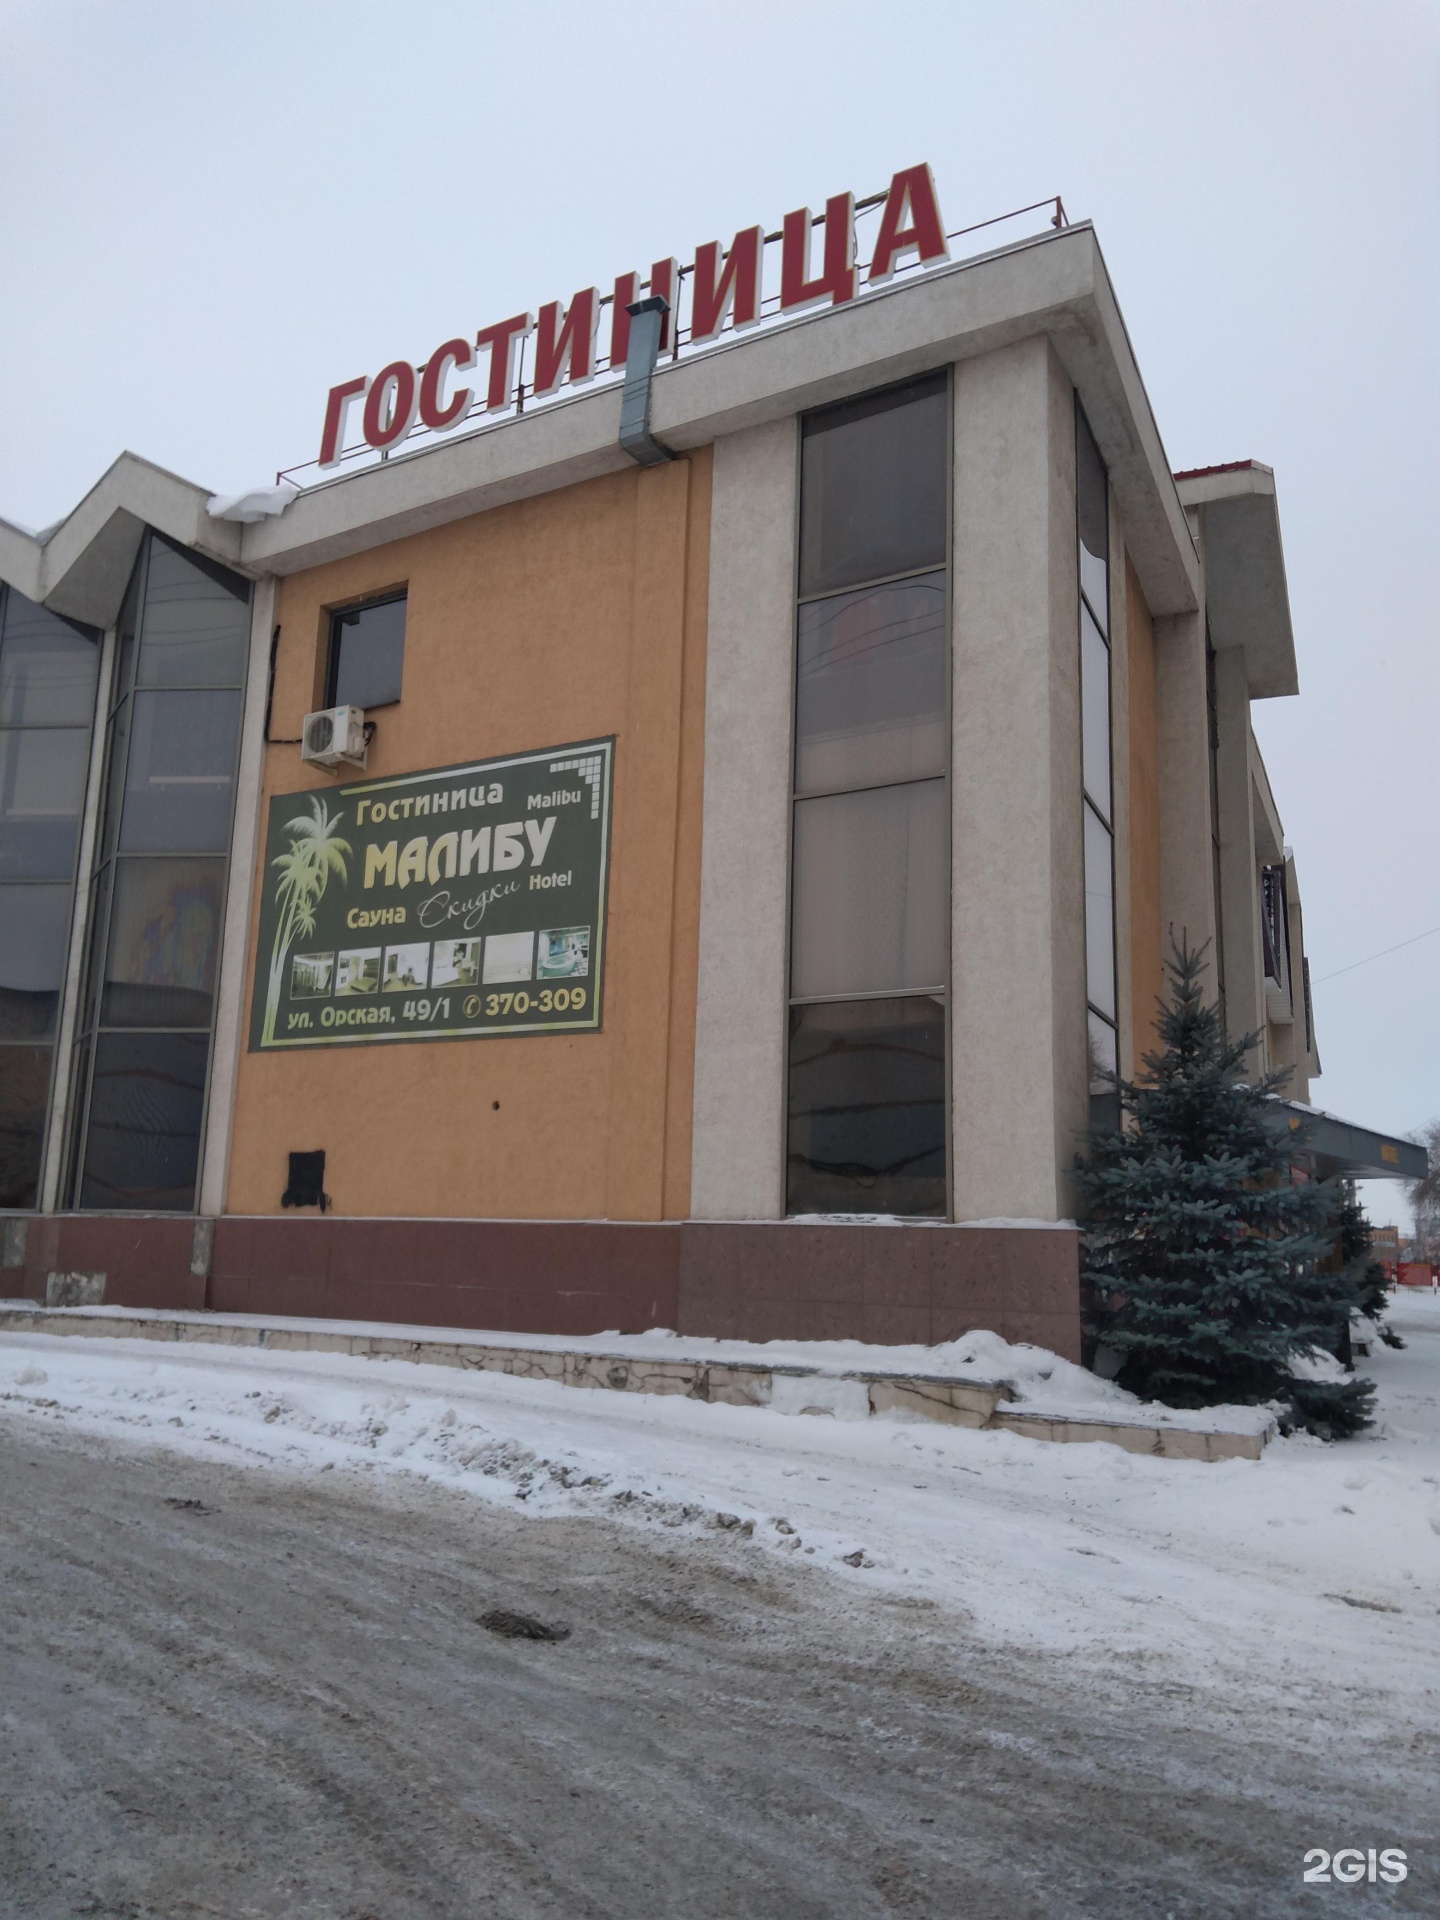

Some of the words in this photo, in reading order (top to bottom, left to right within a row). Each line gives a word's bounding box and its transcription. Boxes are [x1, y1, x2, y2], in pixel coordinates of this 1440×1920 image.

[318, 161, 951, 469] ГОСТИНИЦА
[356, 783, 504, 826] Гостиница
[527, 789, 582, 811] Malibu
[363, 816, 557, 890] МАЛИБУ
[529, 870, 572, 891] Hotel
[347, 906, 406, 929] Сауна
[417, 880, 521, 931] Скидки
[287, 1011, 314, 1030] ул.
[320, 1006, 396, 1027] Орская,
[402, 997, 450, 1023] 49/1
[485, 987, 587, 1016] 370-309
